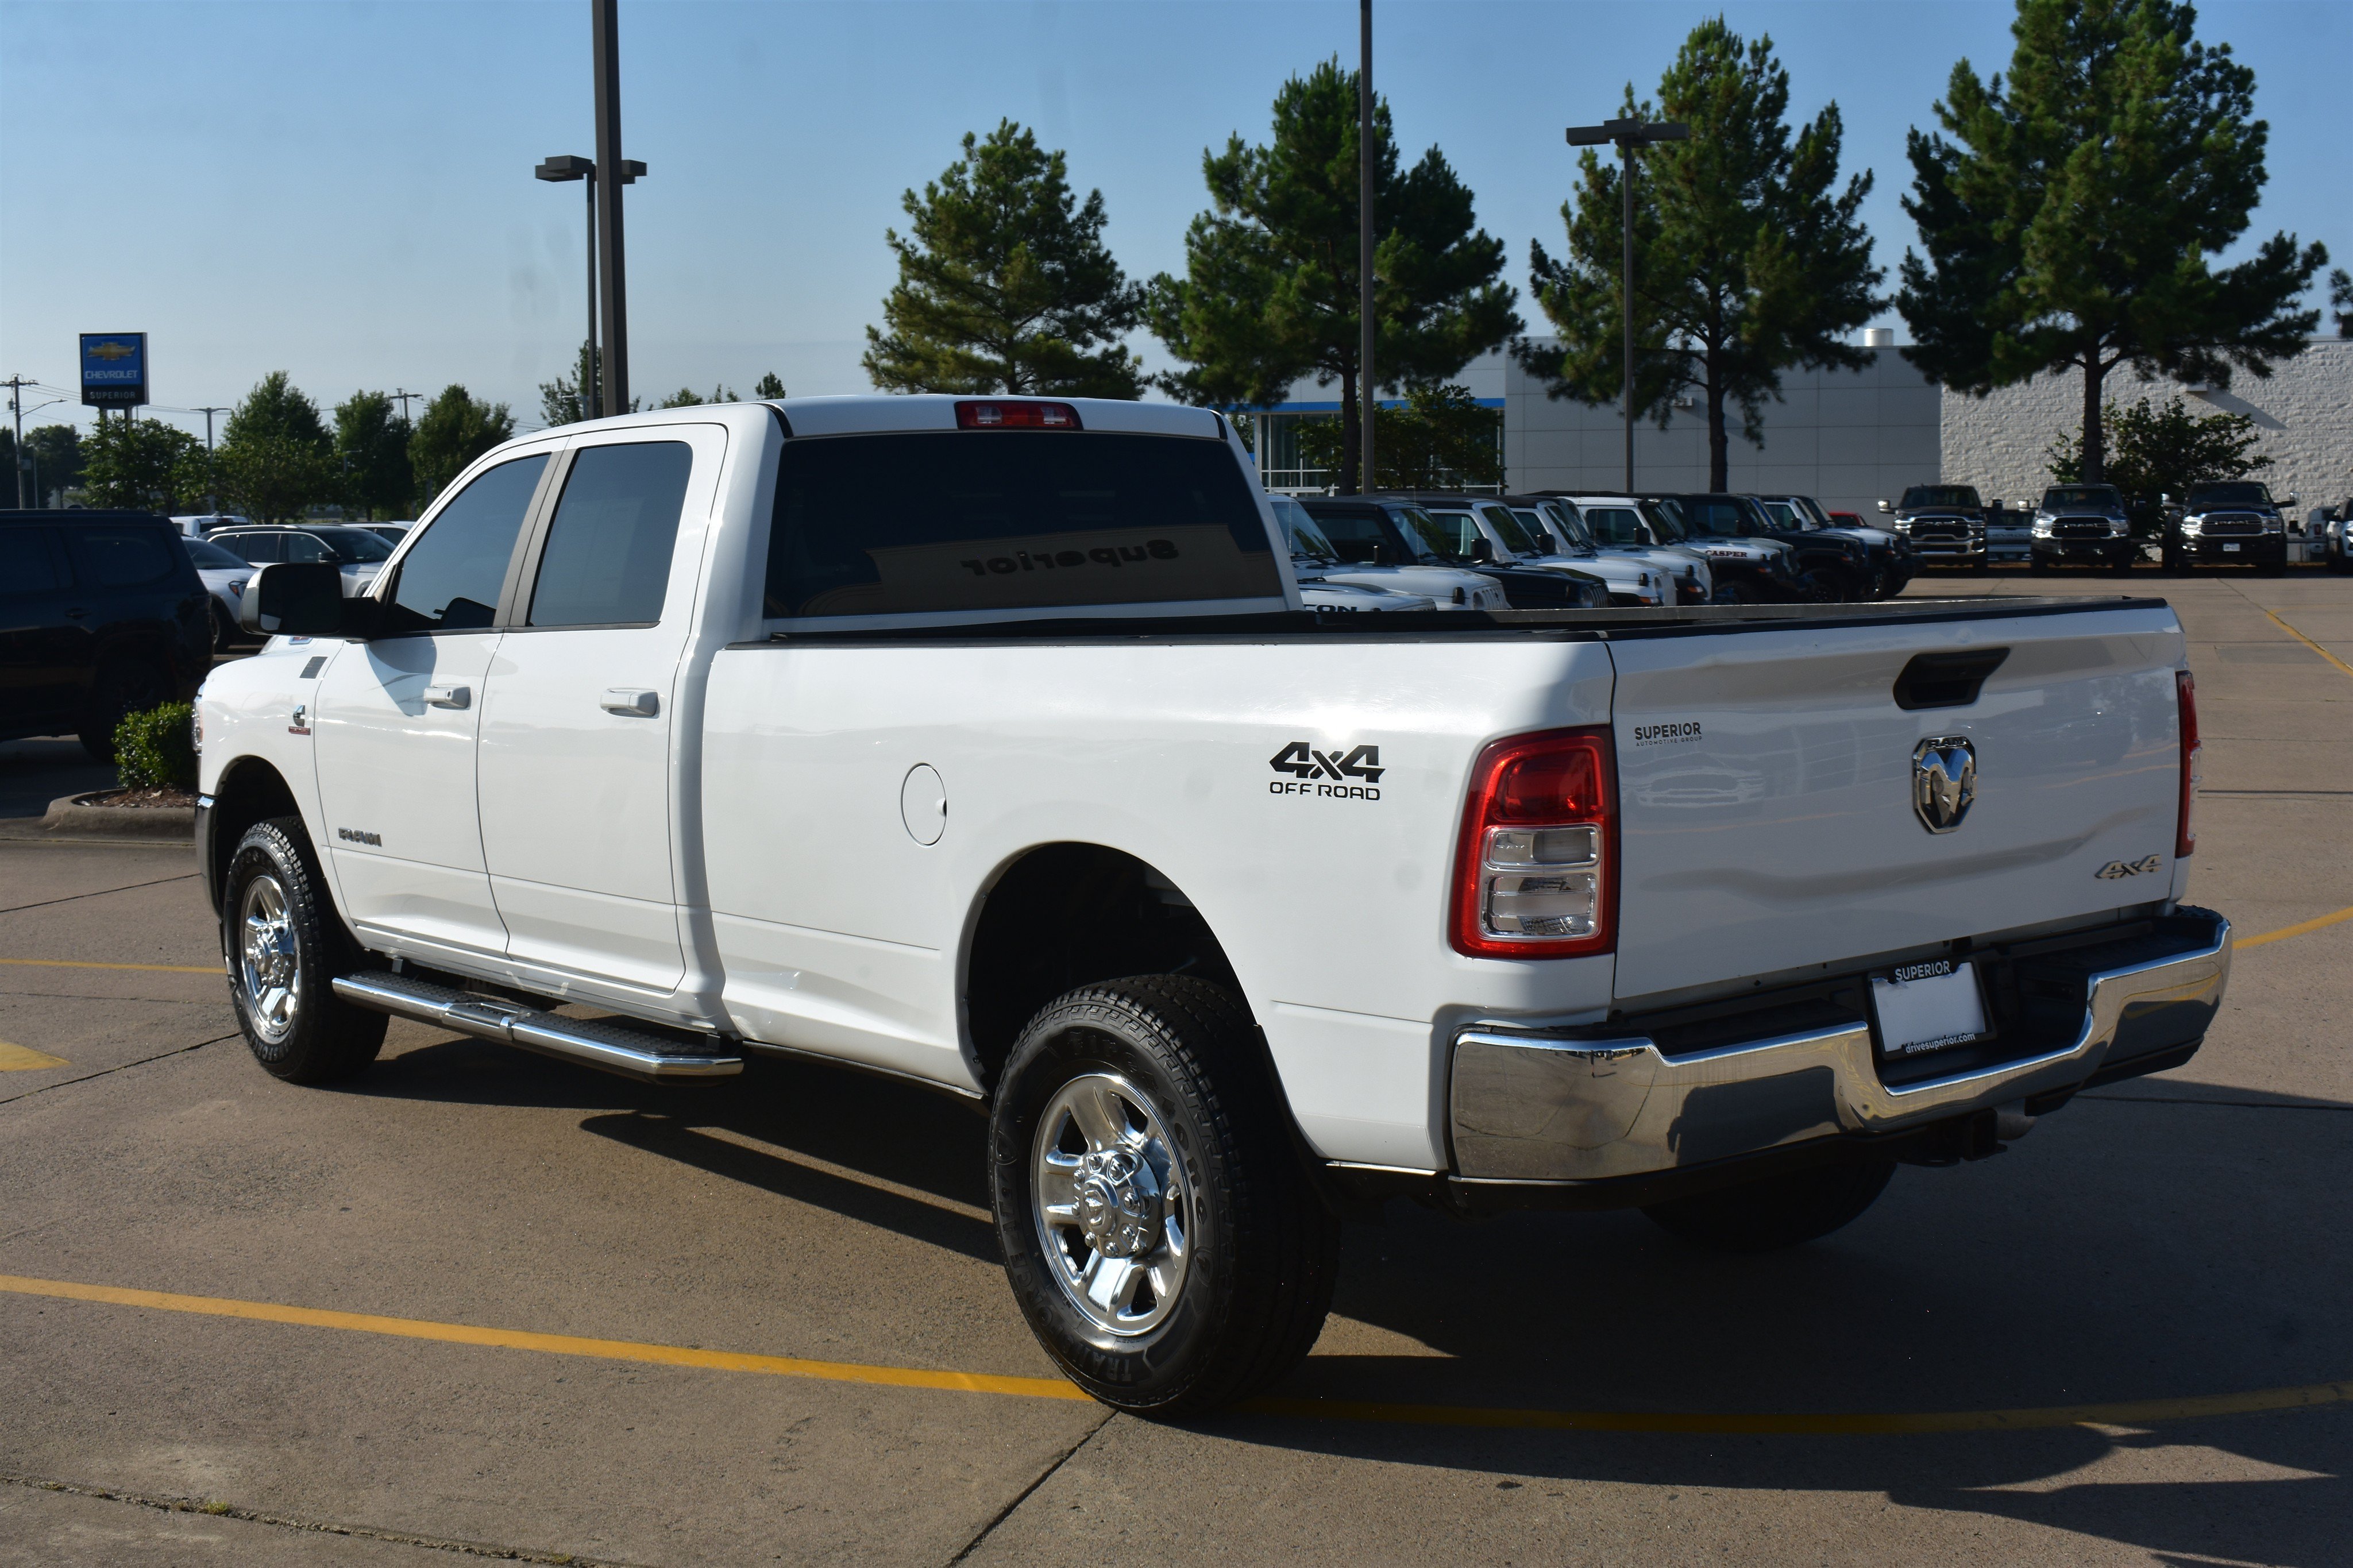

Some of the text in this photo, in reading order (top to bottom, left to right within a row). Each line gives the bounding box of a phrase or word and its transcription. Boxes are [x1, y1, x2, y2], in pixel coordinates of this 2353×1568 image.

[85, 370, 138, 379] CHEVROLET
[90, 391, 136, 399] SUPERIOR
[1634, 722, 1702, 740] SUPERIOR
[1636, 737, 1678, 747] AUTOMOTIVE
[1270, 782, 1380, 801] OFF ROAD
[338, 827, 382, 847] RAM
[1895, 960, 1951, 981] SUPERIOR
[1905, 1033, 1976, 1054] drivesuperior.com
